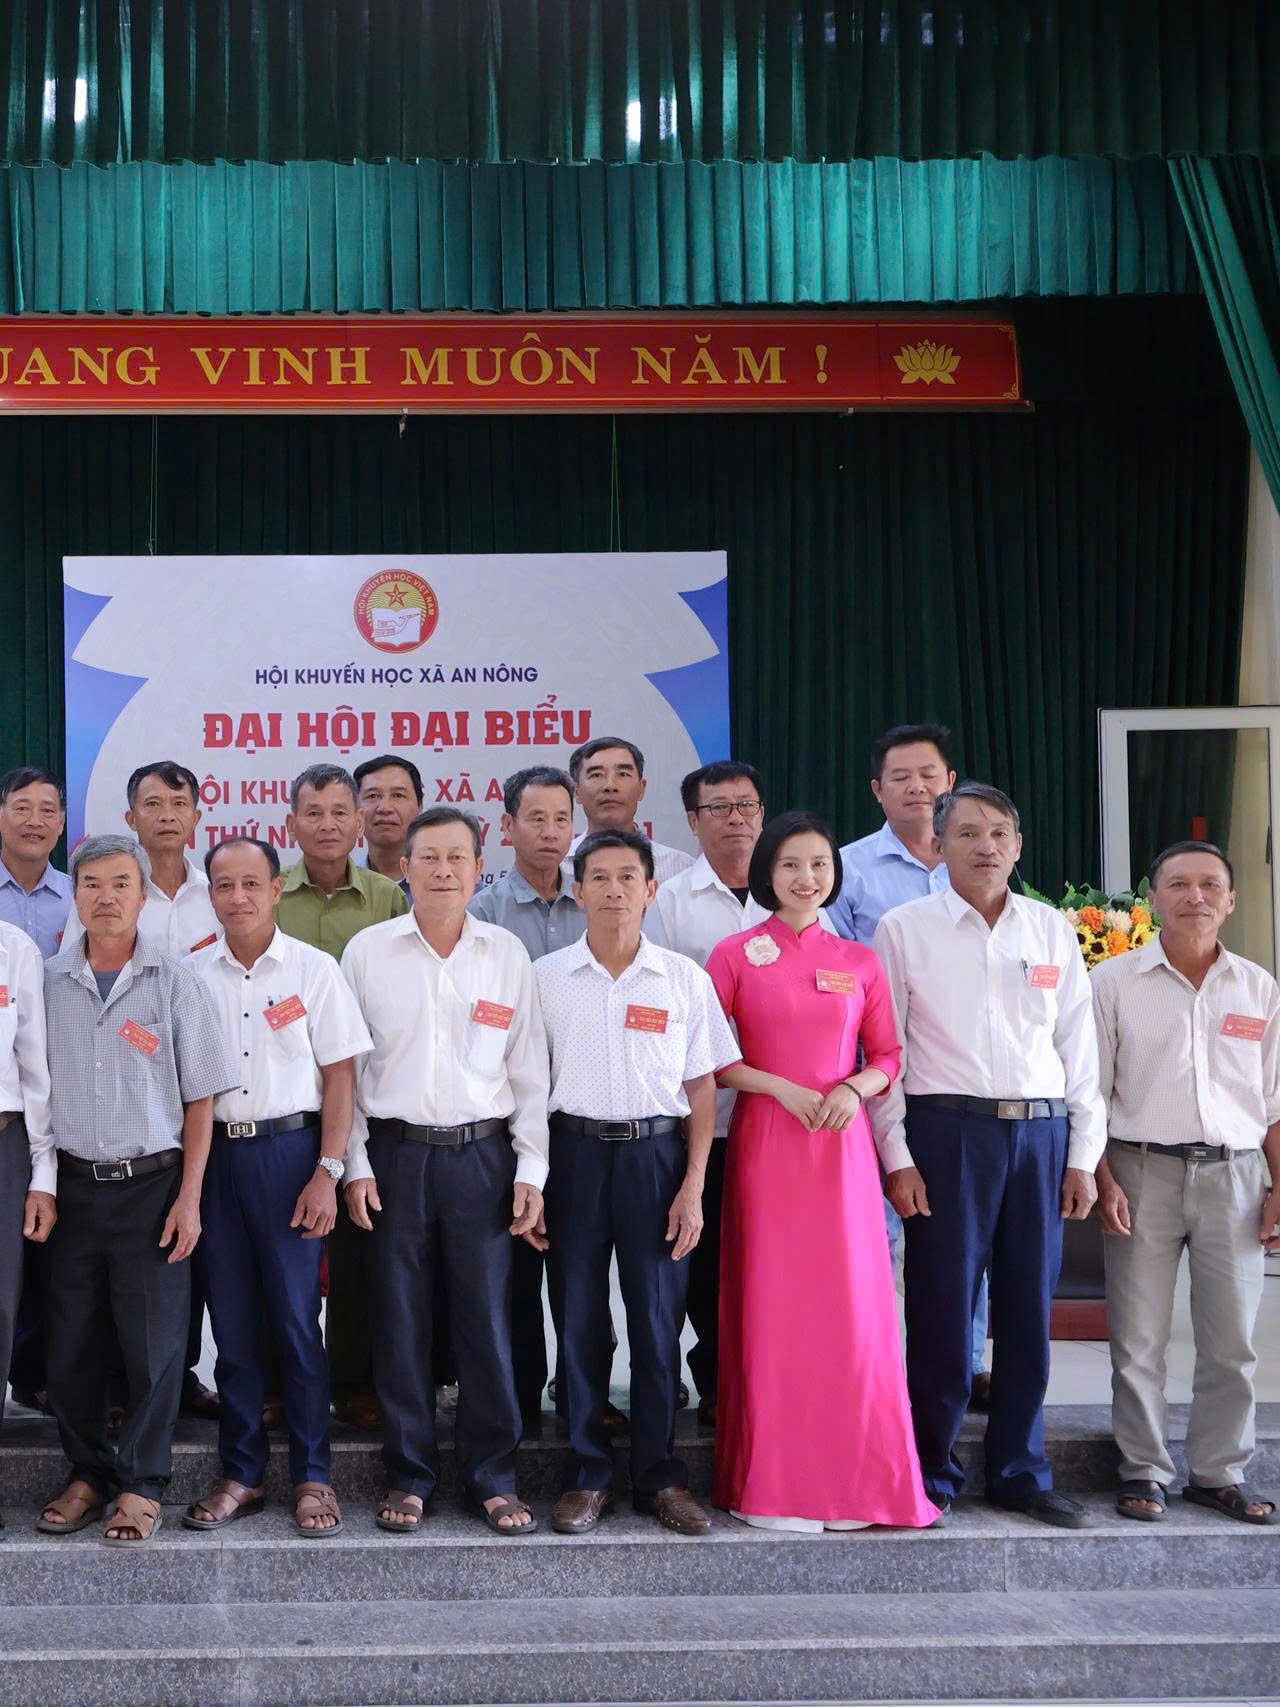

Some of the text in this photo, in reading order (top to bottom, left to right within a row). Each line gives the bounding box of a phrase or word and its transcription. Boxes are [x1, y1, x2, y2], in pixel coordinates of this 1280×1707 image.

[191, 346, 372, 385] VINH
[400, 332, 600, 385] MUÔN
[632, 334, 786, 385] NĂM
[255, 662, 539, 689] HỘI KHUYẾN HỌC XÃ AN NÔNG
[203, 694, 592, 754] ĐẠI HỘI ĐẠI BIỂU
[200, 774, 230, 812] ỘI
[241, 780, 292, 804] KHU
[435, 772, 476, 802] XÃ
